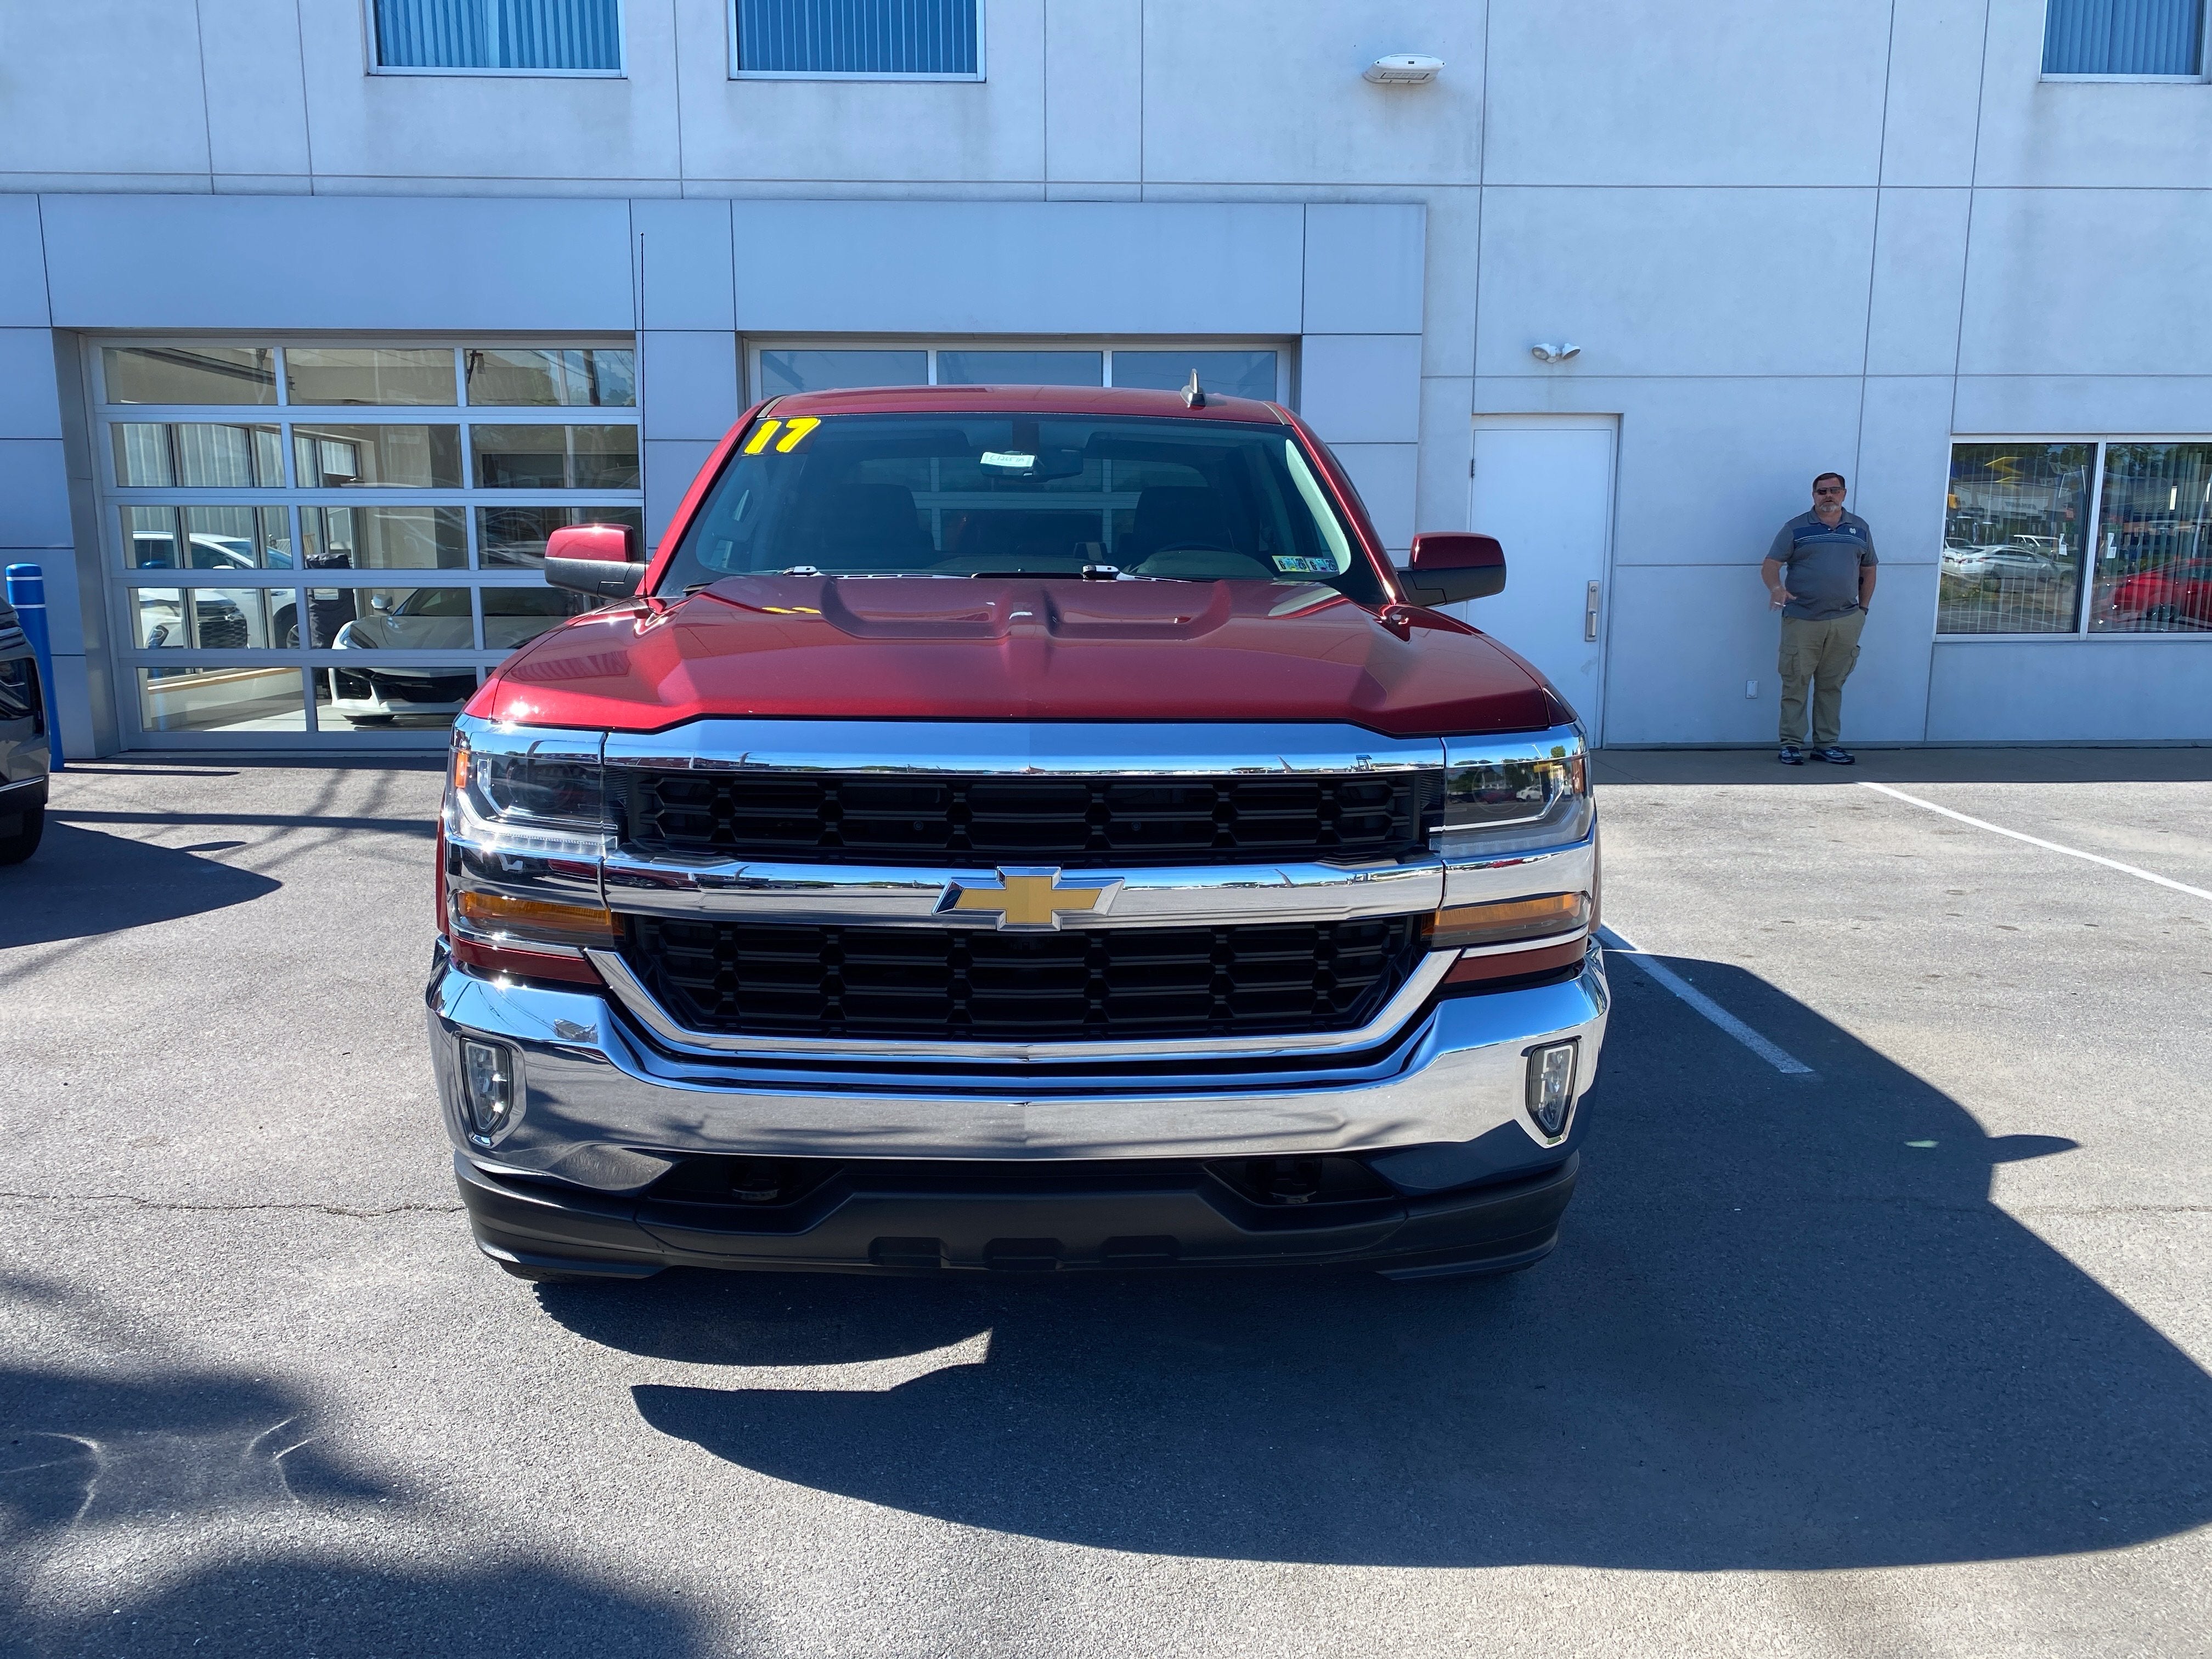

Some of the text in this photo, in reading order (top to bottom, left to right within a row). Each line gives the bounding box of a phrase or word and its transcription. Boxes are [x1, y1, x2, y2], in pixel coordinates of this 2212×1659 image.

[744, 417, 821, 454] 17
[1278, 560, 1286, 569] 6
[1310, 561, 1317, 570] 6
